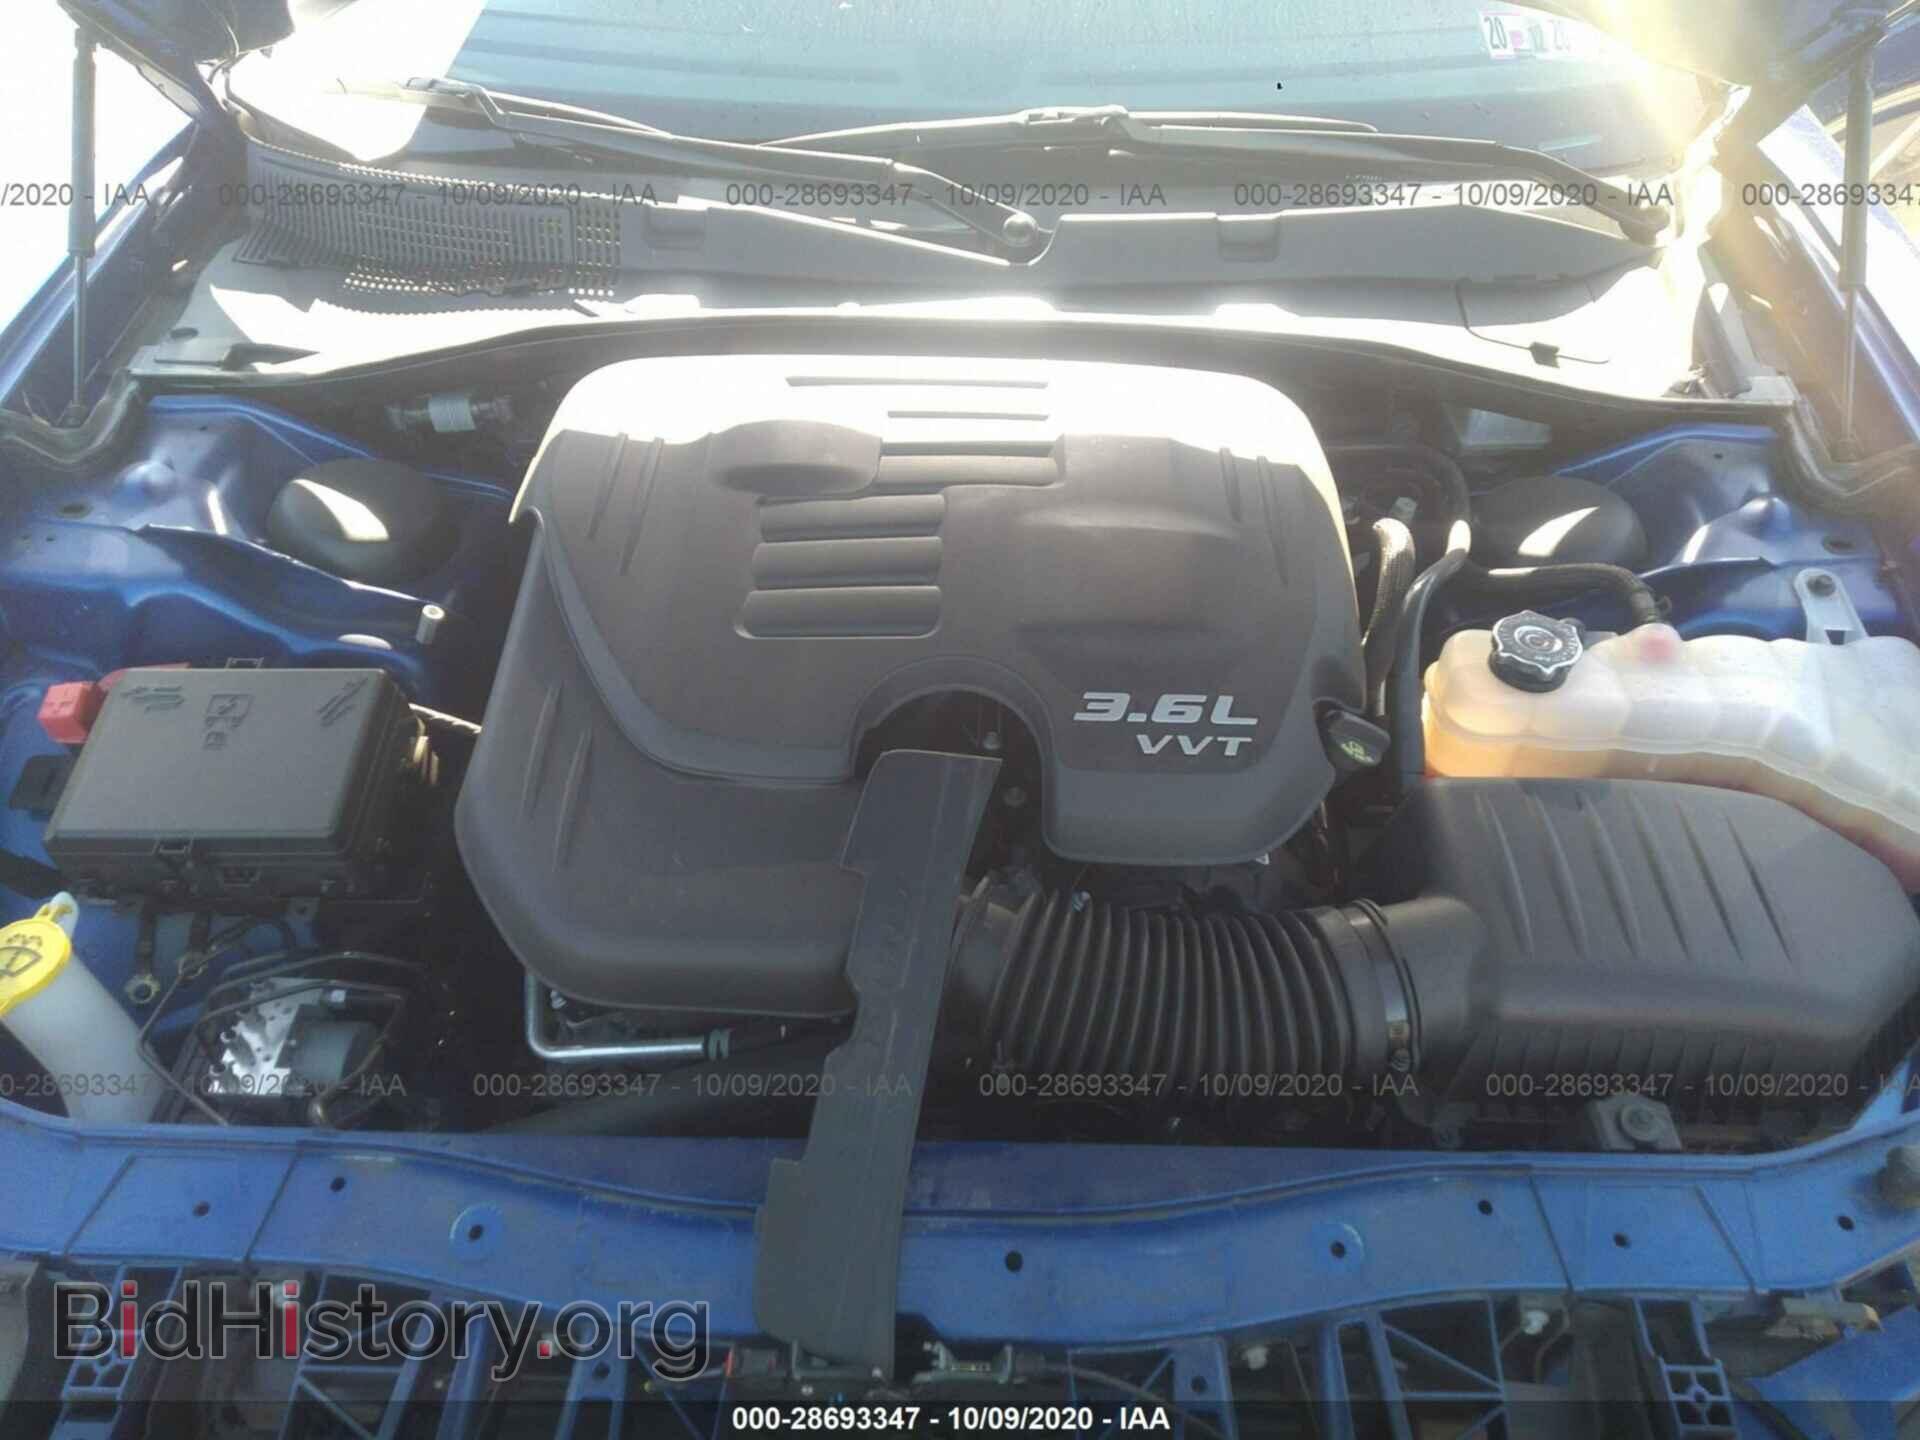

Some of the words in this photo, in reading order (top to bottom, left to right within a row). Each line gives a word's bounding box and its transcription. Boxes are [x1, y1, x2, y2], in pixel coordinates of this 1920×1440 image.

[1483, 15, 1508, 50] 20
[1073, 691, 1258, 725] 3.6L
[1136, 734, 1252, 756] VVT
